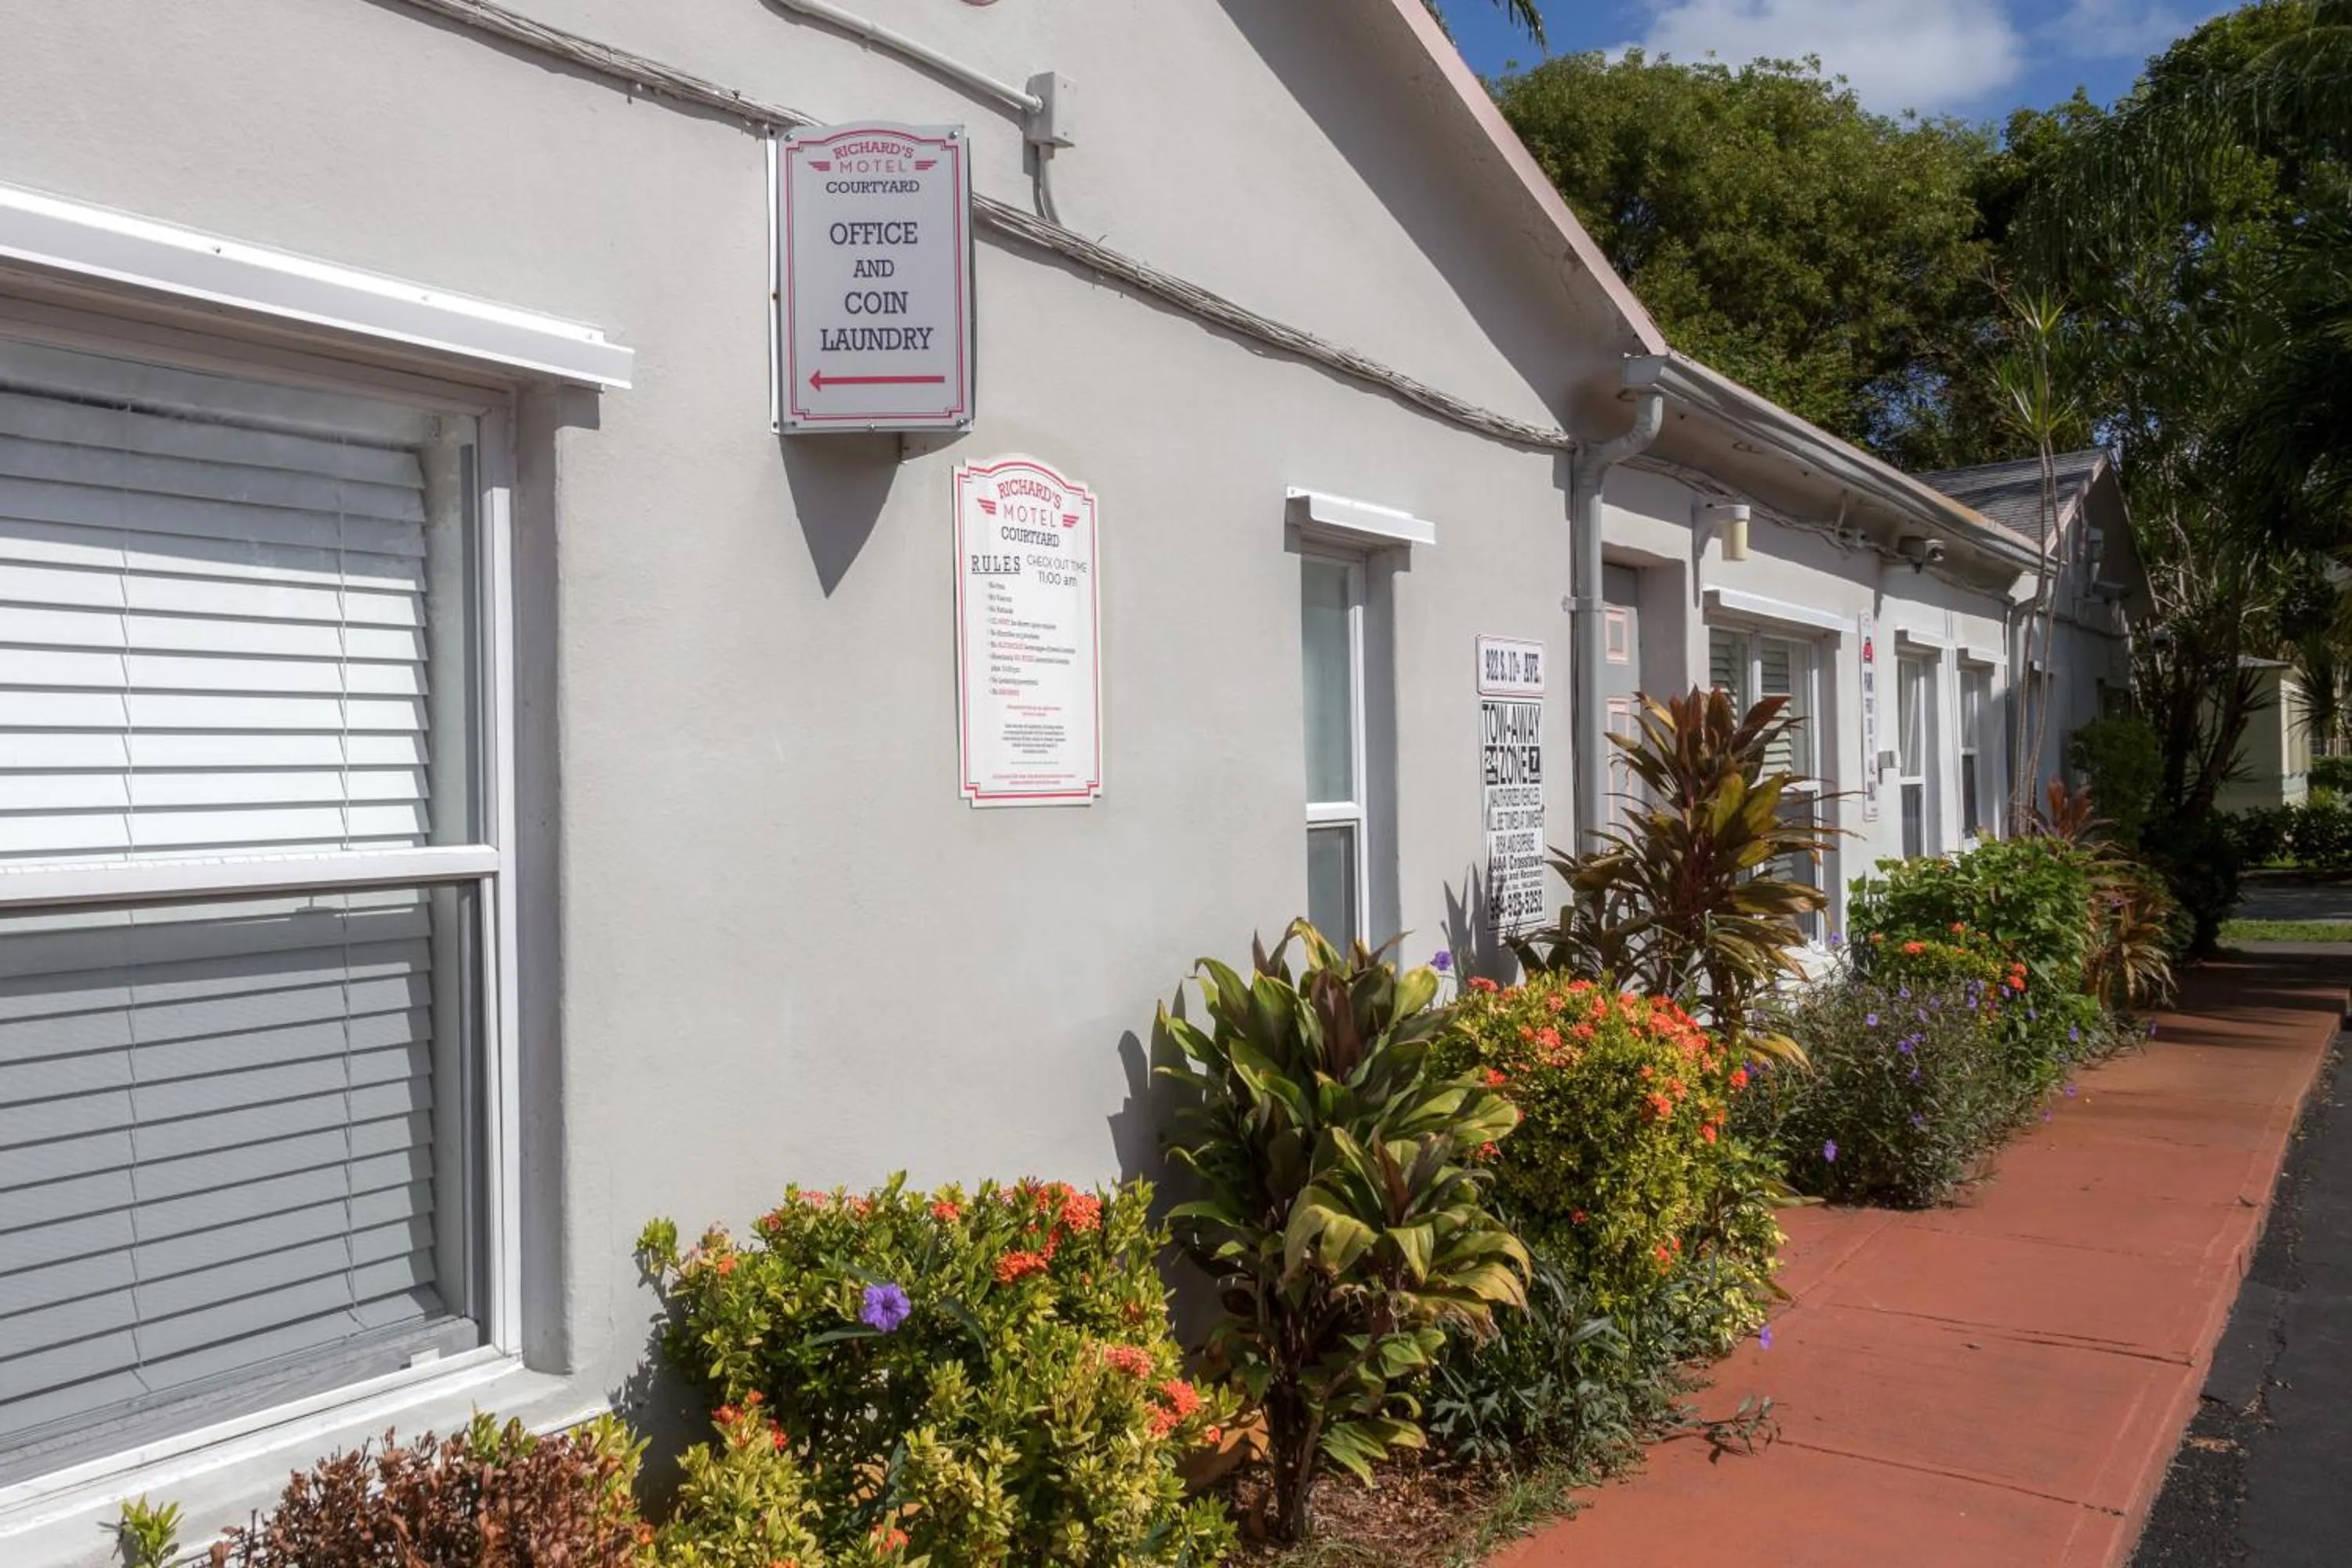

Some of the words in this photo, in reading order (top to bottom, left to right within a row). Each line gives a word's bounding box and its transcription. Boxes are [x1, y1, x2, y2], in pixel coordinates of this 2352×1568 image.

[832, 141, 914, 160] RICHARD'S
[840, 159, 907, 173] MOTEL
[826, 180, 920, 194] COURTYARD
[829, 222, 918, 245] OFFICE
[852, 260, 895, 278] AND
[844, 291, 909, 314] COIN
[820, 326, 934, 351] LAUNDRY
[997, 479, 1062, 510] RICHARD'S
[1004, 504, 1057, 528] MOTEL
[1001, 526, 1060, 547] COURTYARD
[971, 554, 1021, 572] RULES
[1026, 554, 1053, 568] CHECK
[1054, 557, 1069, 570] OUT
[1070, 560, 1087, 573] TIME
[1063, 575, 1077, 586] am
[1482, 703, 1541, 744] TOW-AWAY
[1499, 746, 1526, 785] ZONE
